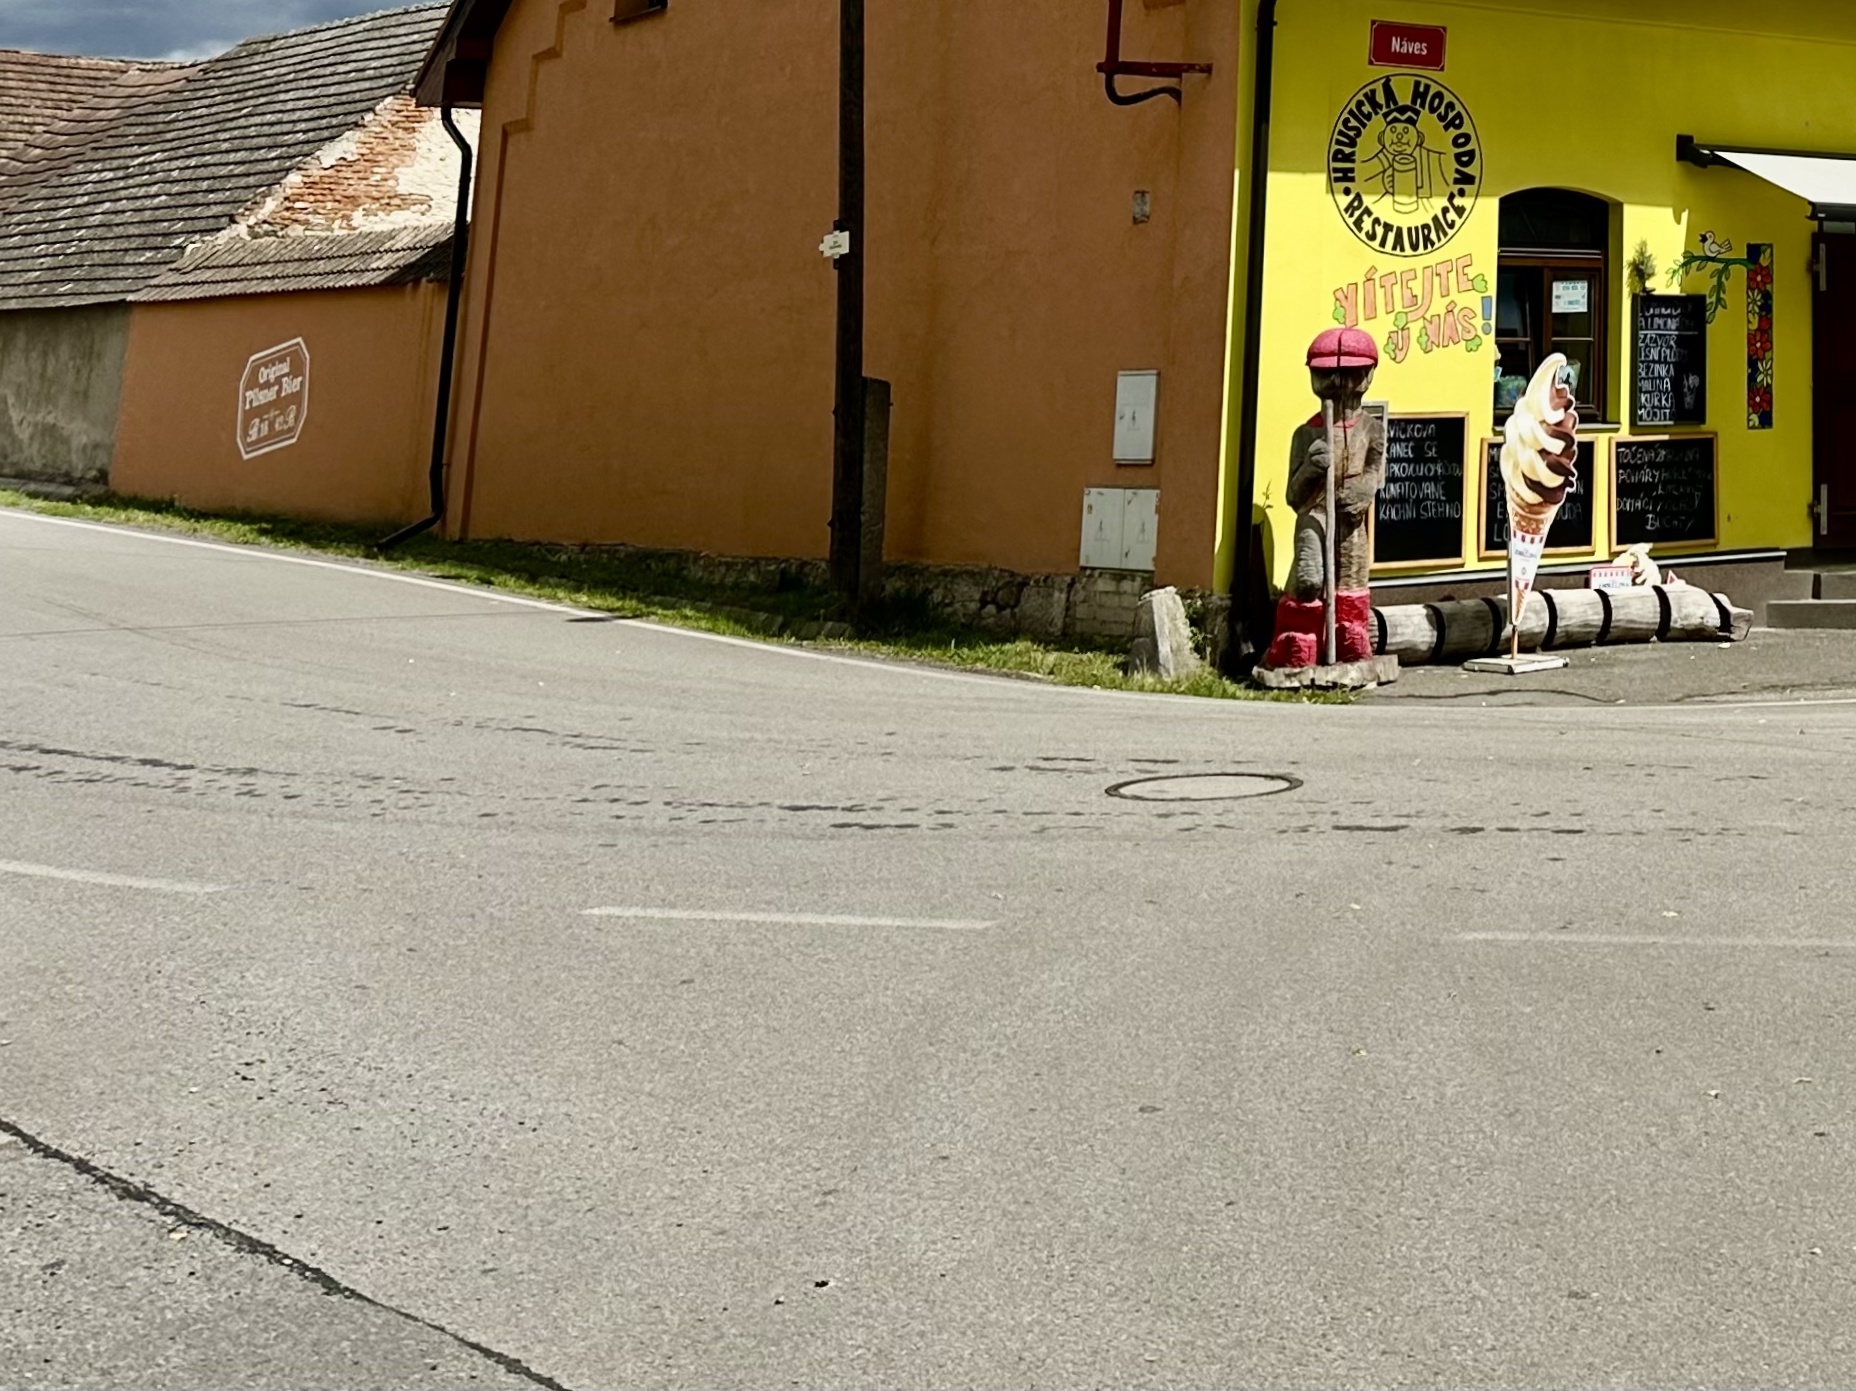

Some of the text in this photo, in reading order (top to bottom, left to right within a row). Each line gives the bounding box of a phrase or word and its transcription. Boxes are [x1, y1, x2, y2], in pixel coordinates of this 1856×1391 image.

[1391, 36, 1428, 55] Náves
[1331, 76, 1477, 187] HRUSICKÁ HOSPODA
[1343, 191, 1467, 253] RESTAURACE
[1333, 253, 1474, 329] VÍTEJTE
[1388, 327, 1410, 364] U
